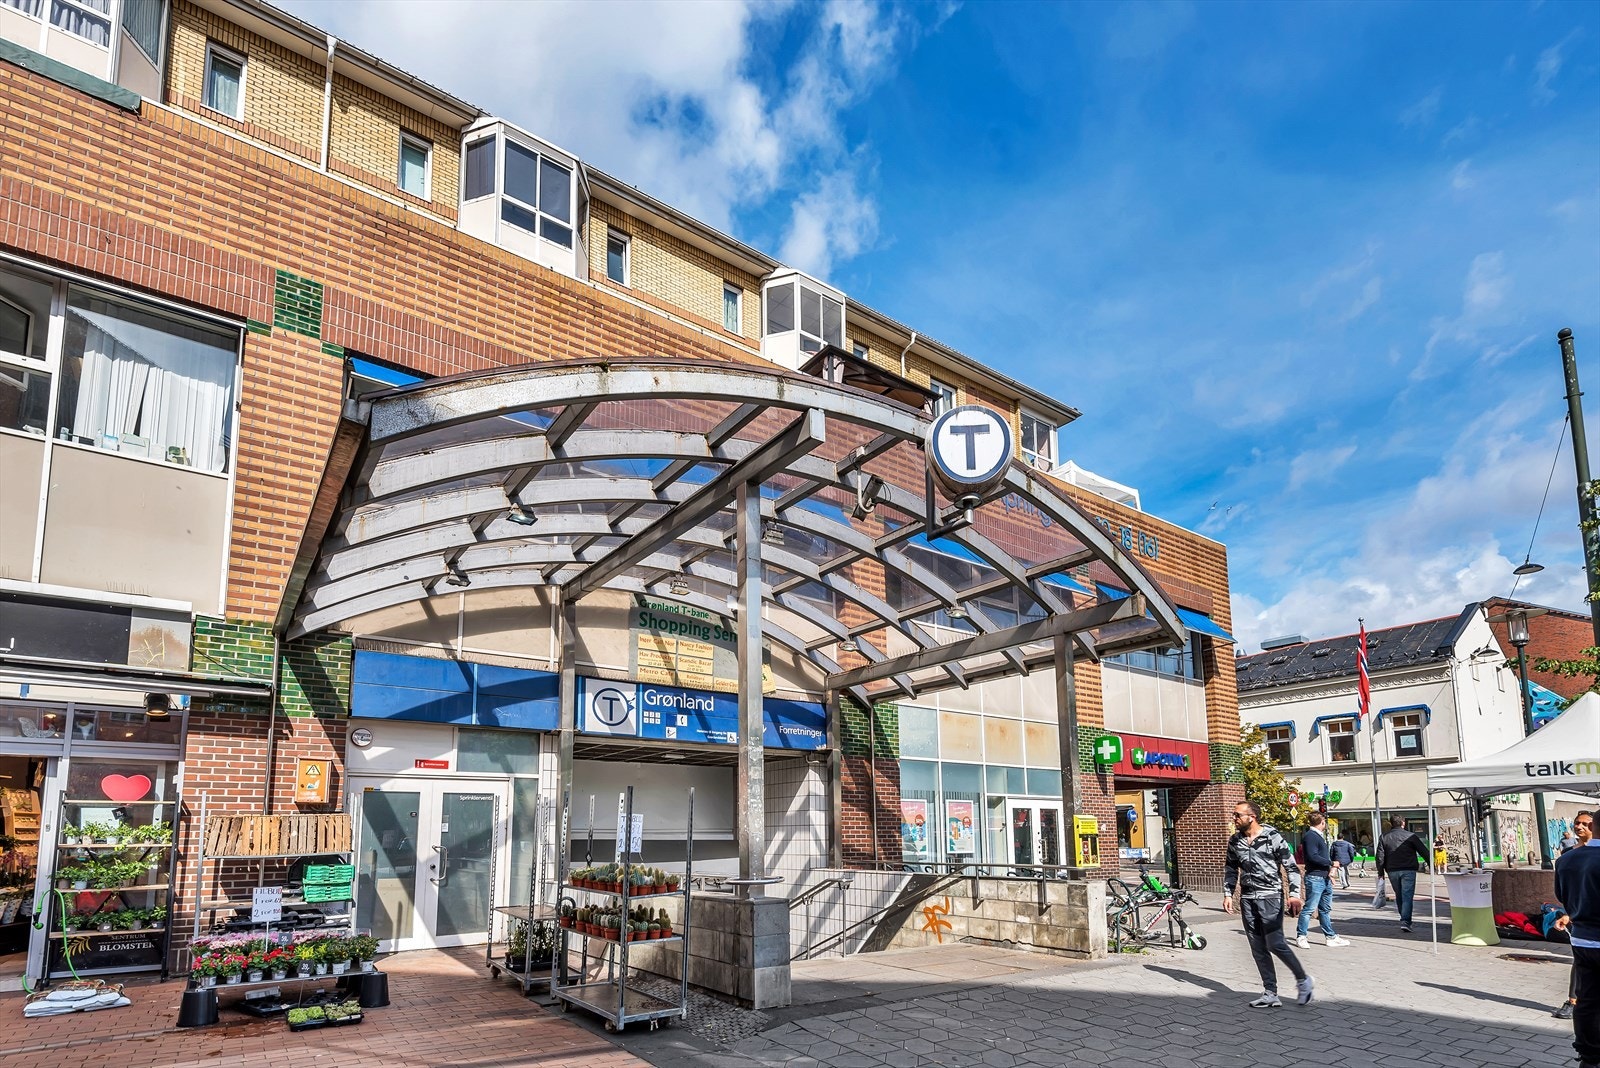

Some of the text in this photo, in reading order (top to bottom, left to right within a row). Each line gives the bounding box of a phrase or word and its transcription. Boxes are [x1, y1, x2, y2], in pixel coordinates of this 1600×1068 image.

[950, 424, 990, 470] T
[1138, 530, 1159, 561] (16)
[640, 598, 709, 619] Grønland T-bane
[639, 611, 738, 643] Shopping Sen
[640, 667, 659, 675] Metro
[644, 689, 714, 711] Grønland
[779, 725, 822, 738] Forretninger
